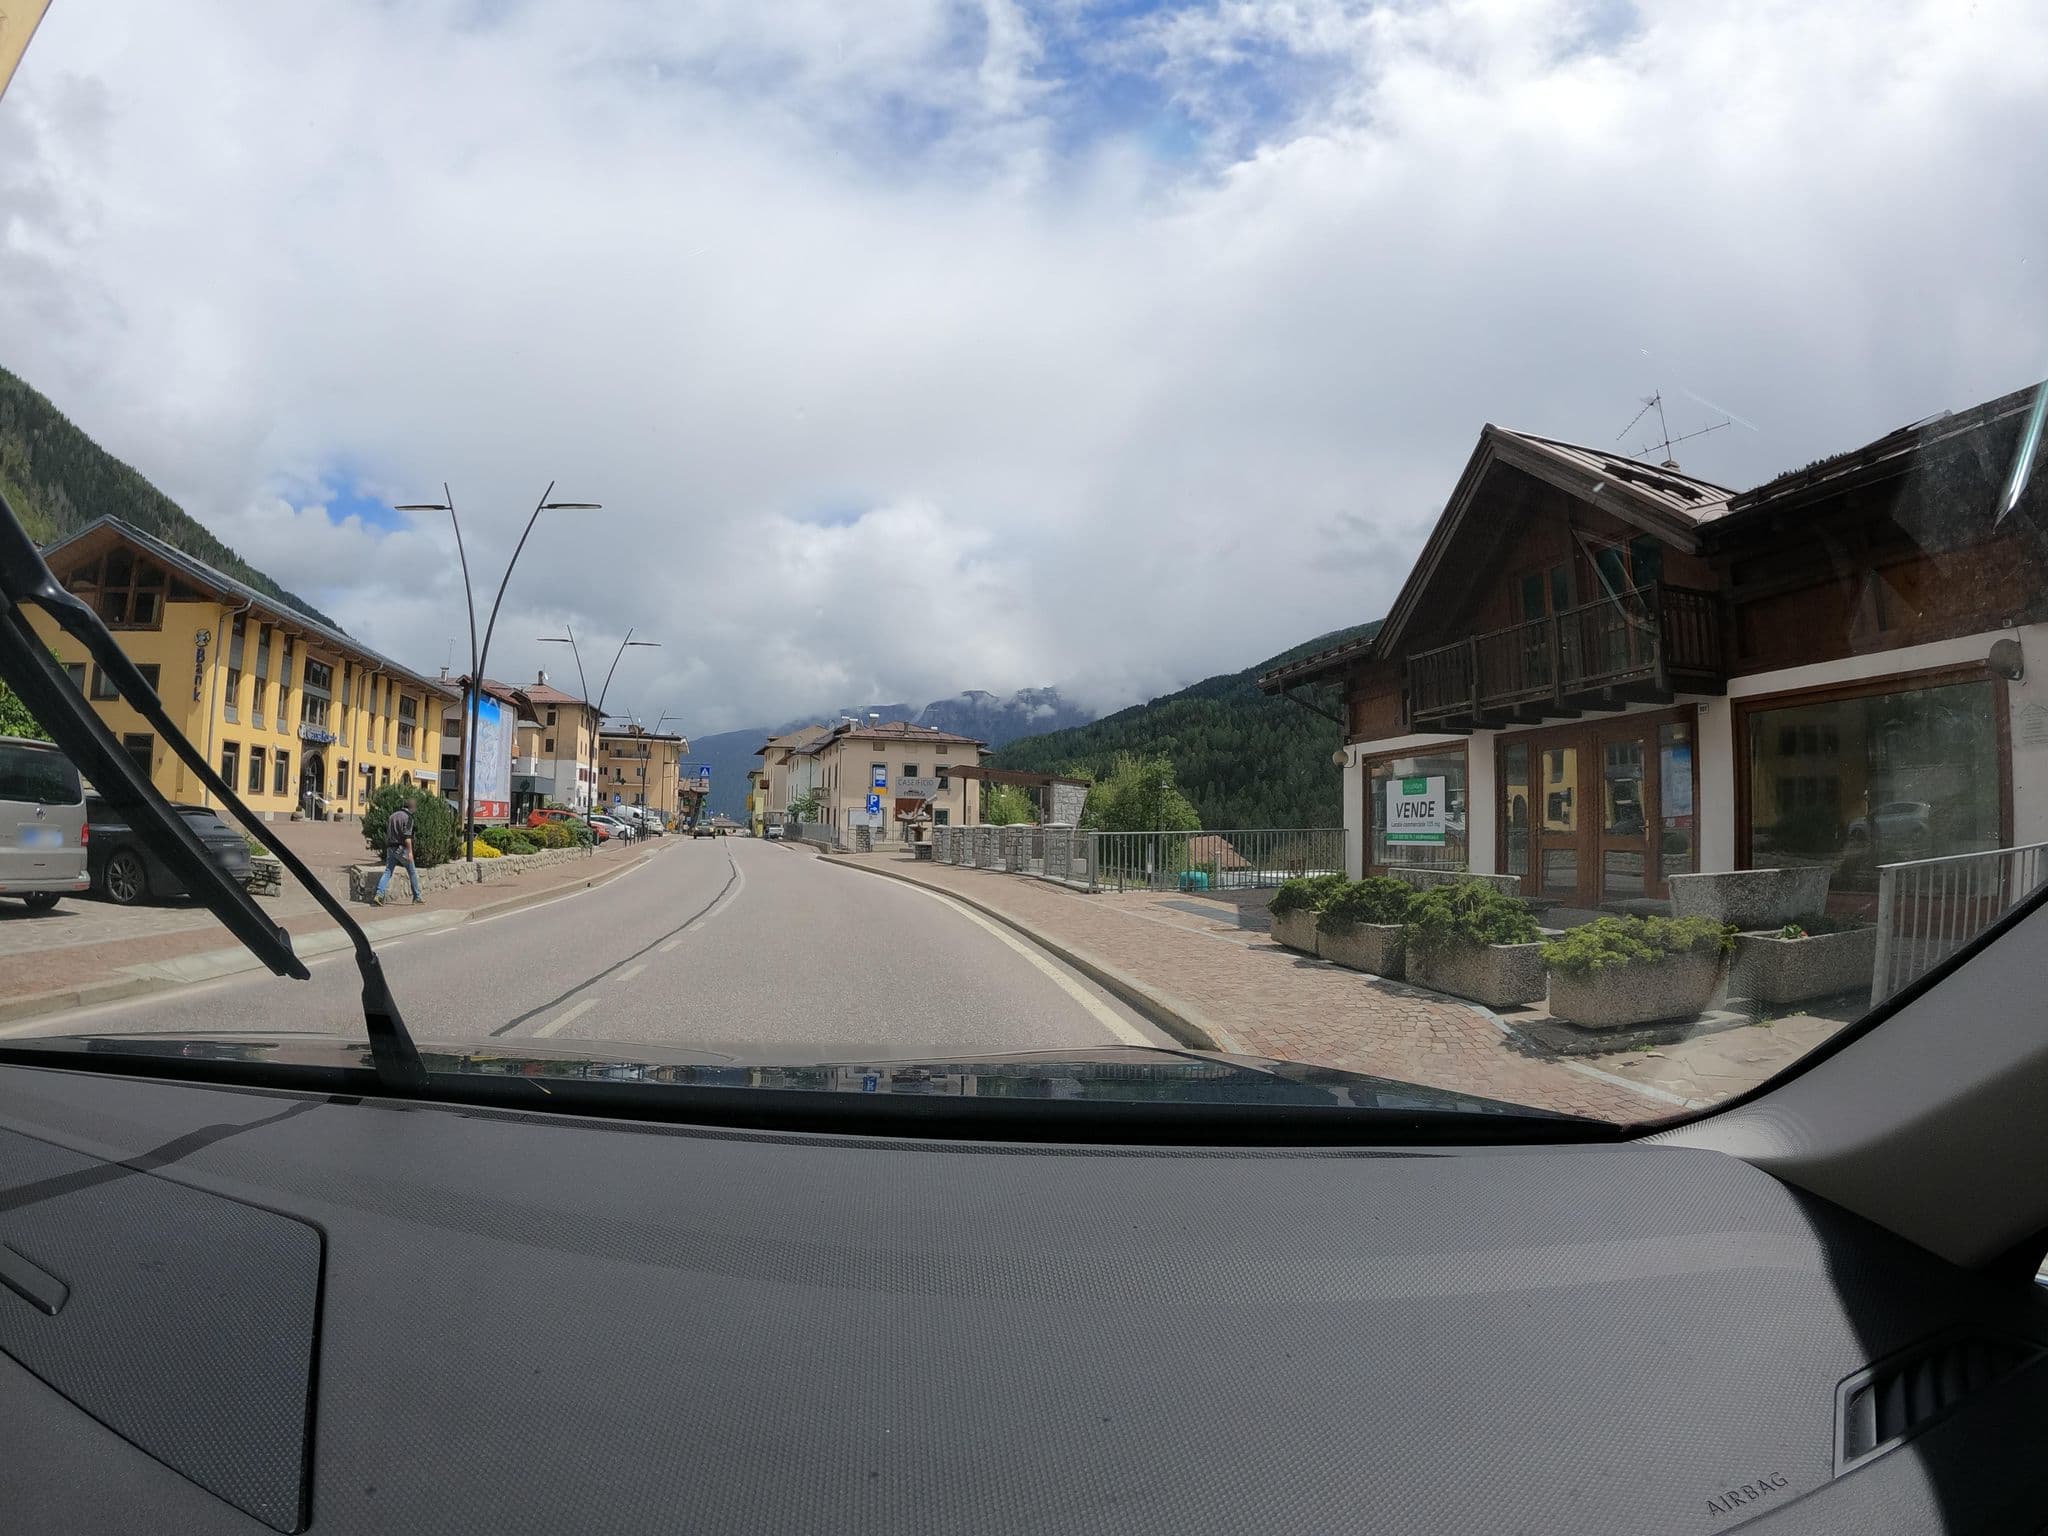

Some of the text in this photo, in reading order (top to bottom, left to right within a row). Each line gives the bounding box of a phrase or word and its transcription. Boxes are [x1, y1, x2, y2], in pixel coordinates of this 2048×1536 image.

[193, 647, 205, 702] Bank
[870, 795, 878, 805] P
[1396, 801, 1435, 818] VENDE
[1706, 1471, 1788, 1516] AIRBAG
